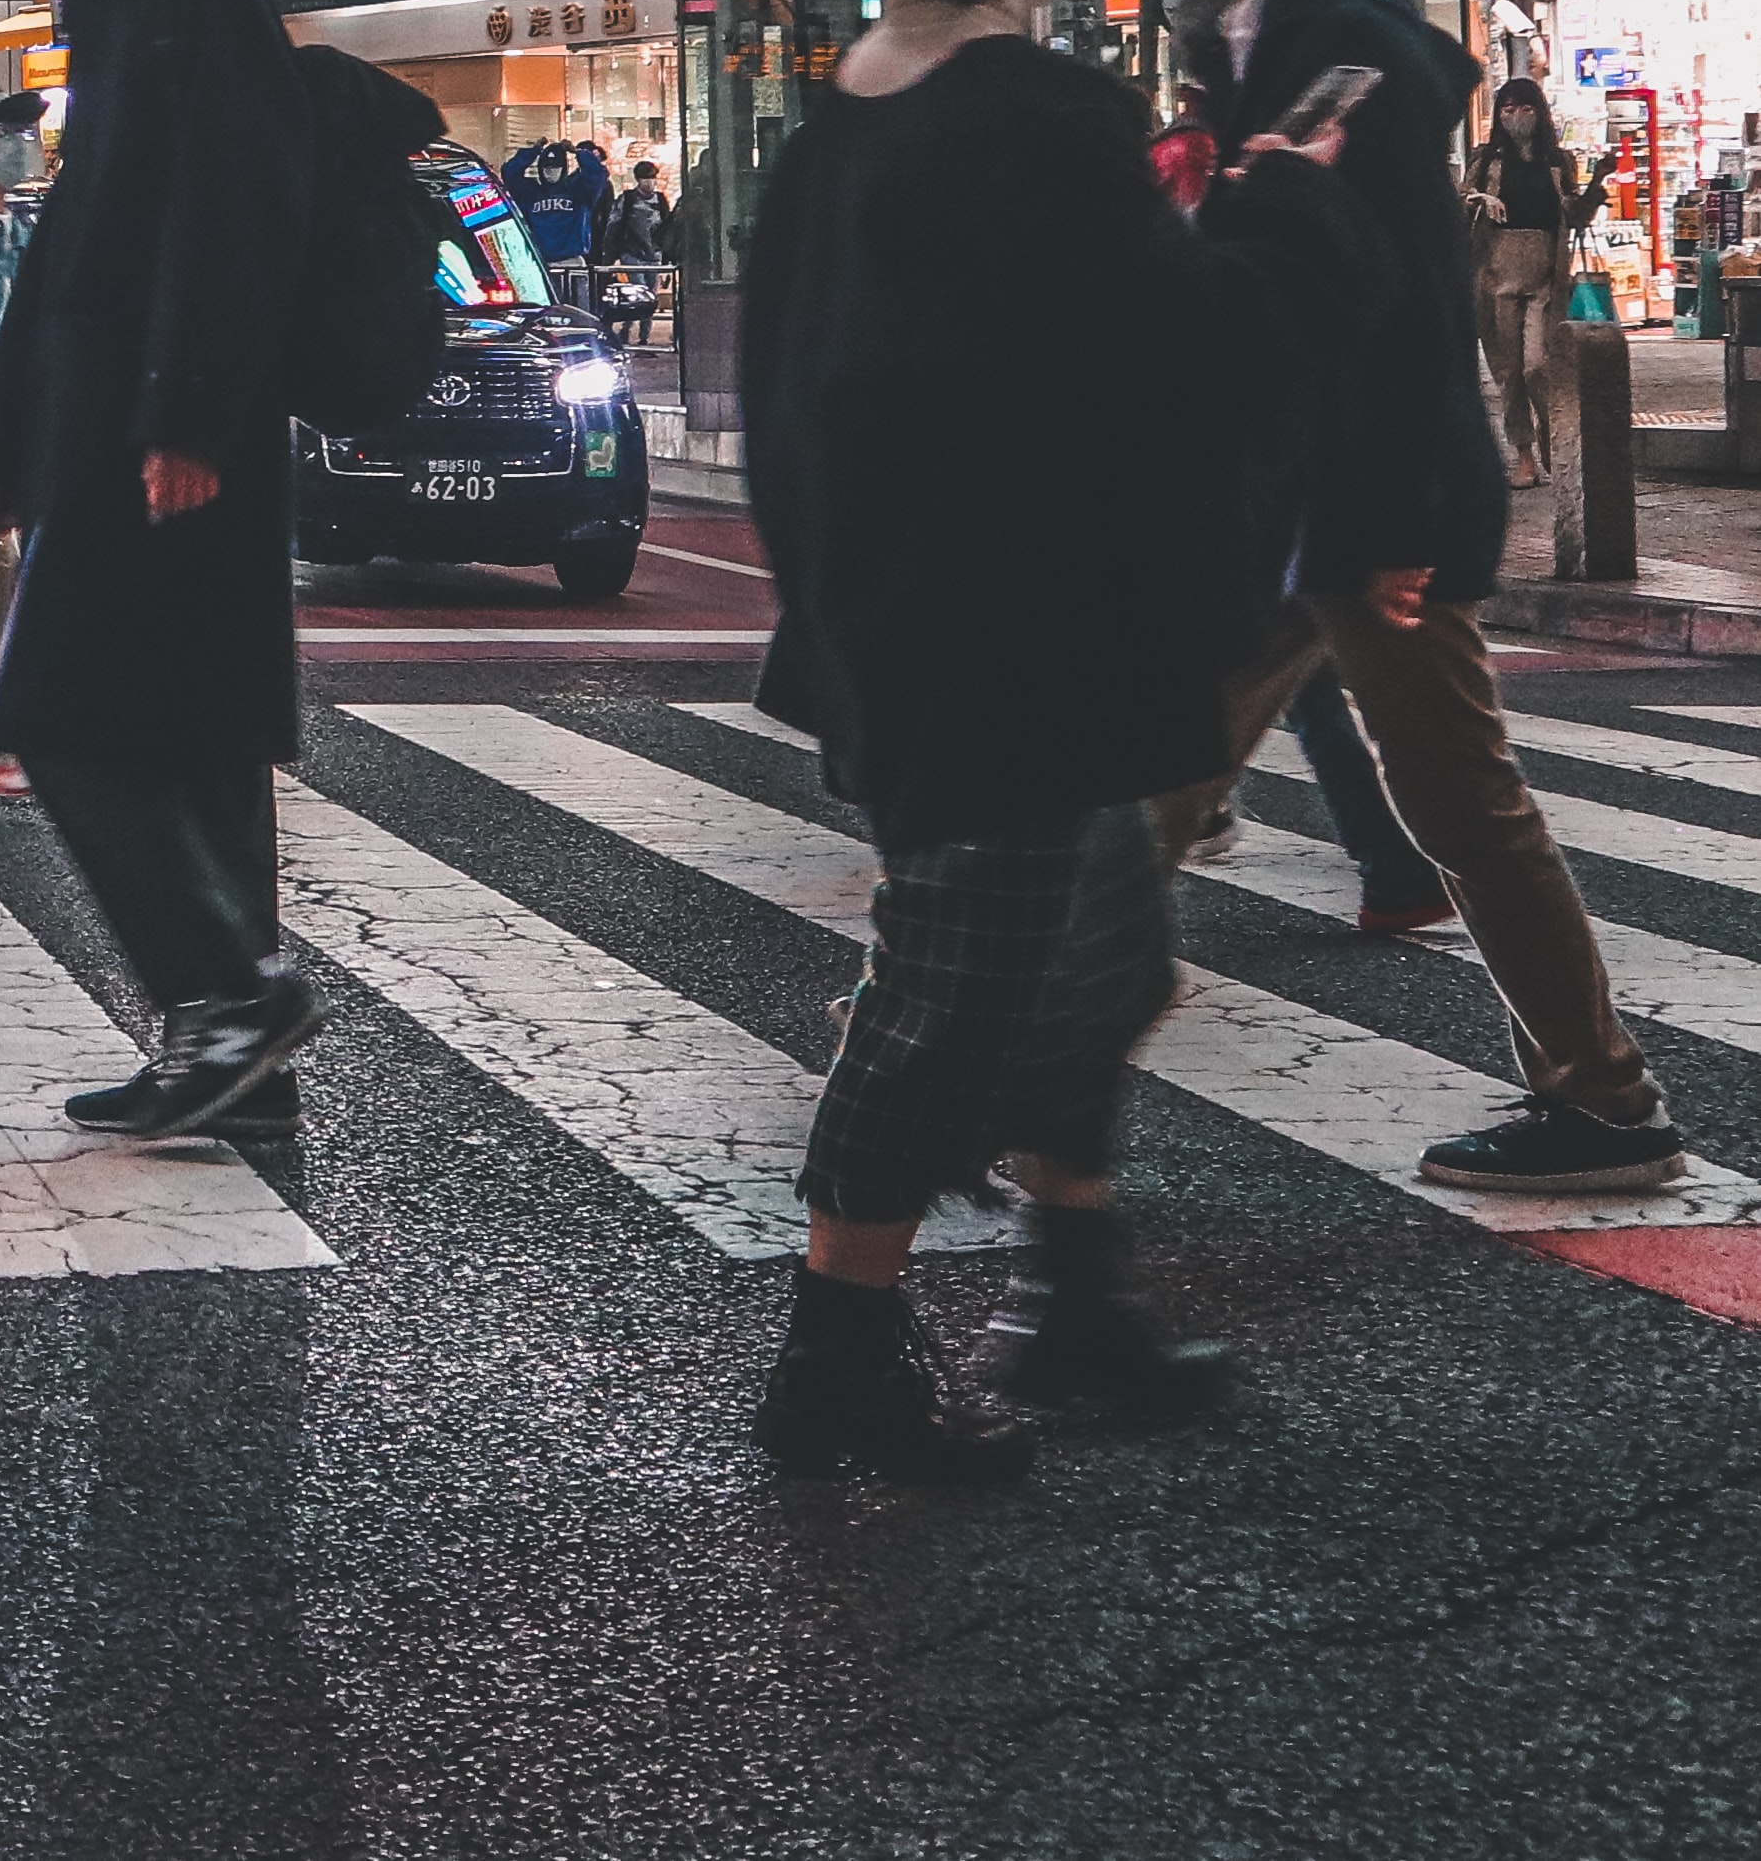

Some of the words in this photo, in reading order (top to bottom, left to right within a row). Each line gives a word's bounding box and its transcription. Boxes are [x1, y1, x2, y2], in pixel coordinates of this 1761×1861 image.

[532, 198, 575, 213] DUKE
[456, 459, 482, 473] 510
[426, 475, 496, 501] 62-03
